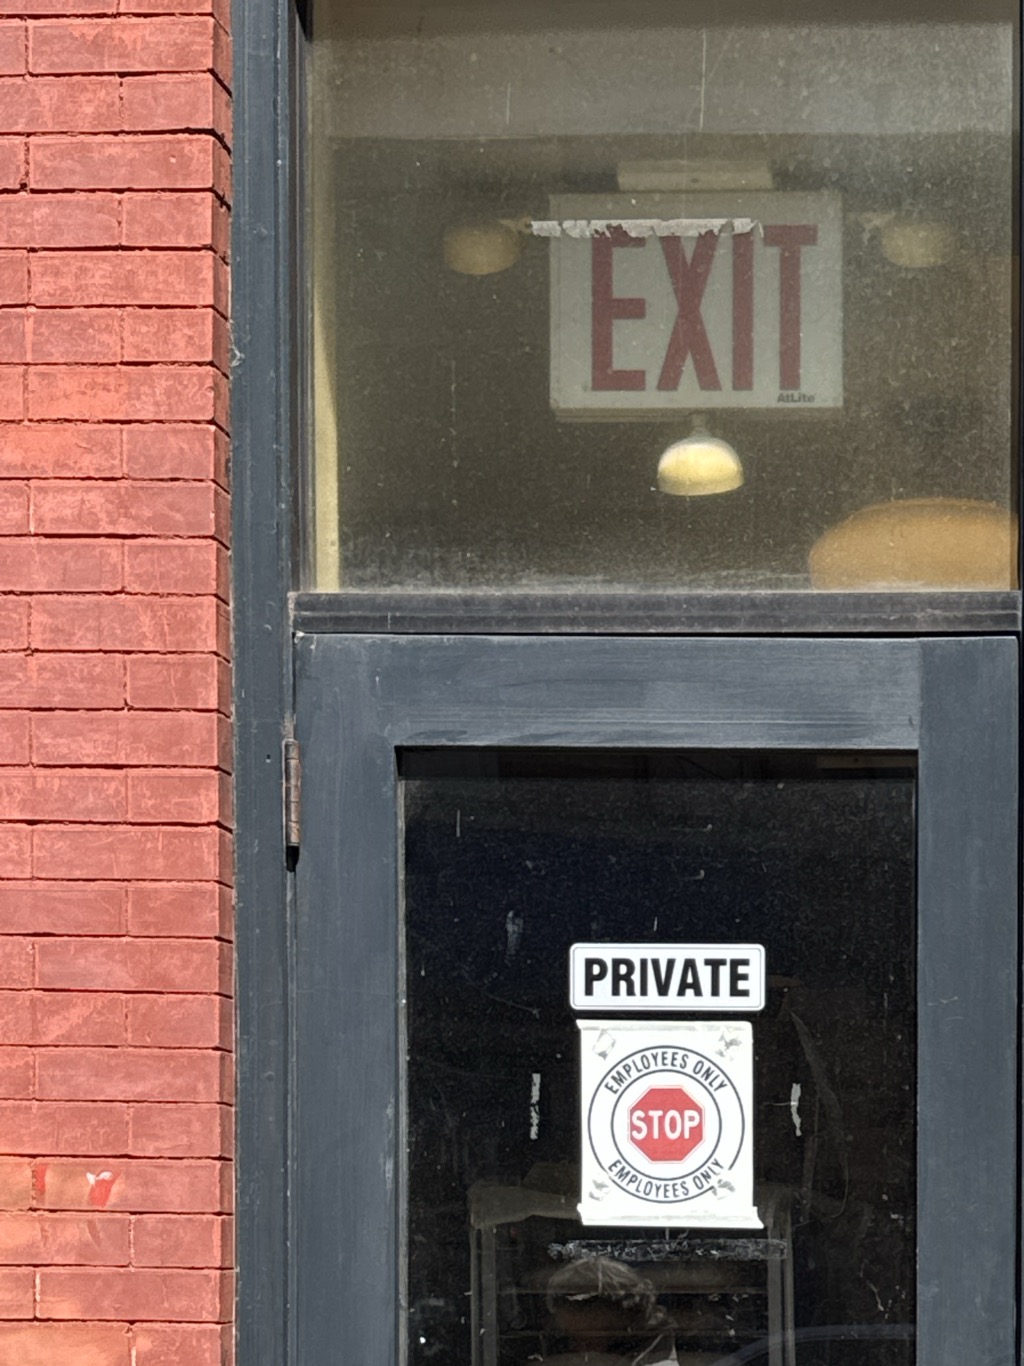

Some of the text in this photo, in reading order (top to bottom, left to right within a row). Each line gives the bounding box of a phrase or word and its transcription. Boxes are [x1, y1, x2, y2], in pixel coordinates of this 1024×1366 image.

[591, 220, 818, 391] EXIT
[584, 958, 751, 998] PRIVATE
[604, 1051, 728, 1095] EMPLOYEES ONLY
[632, 1109, 700, 1140] STOP
[608, 1158, 724, 1198] EMPLOYEES ONLY
